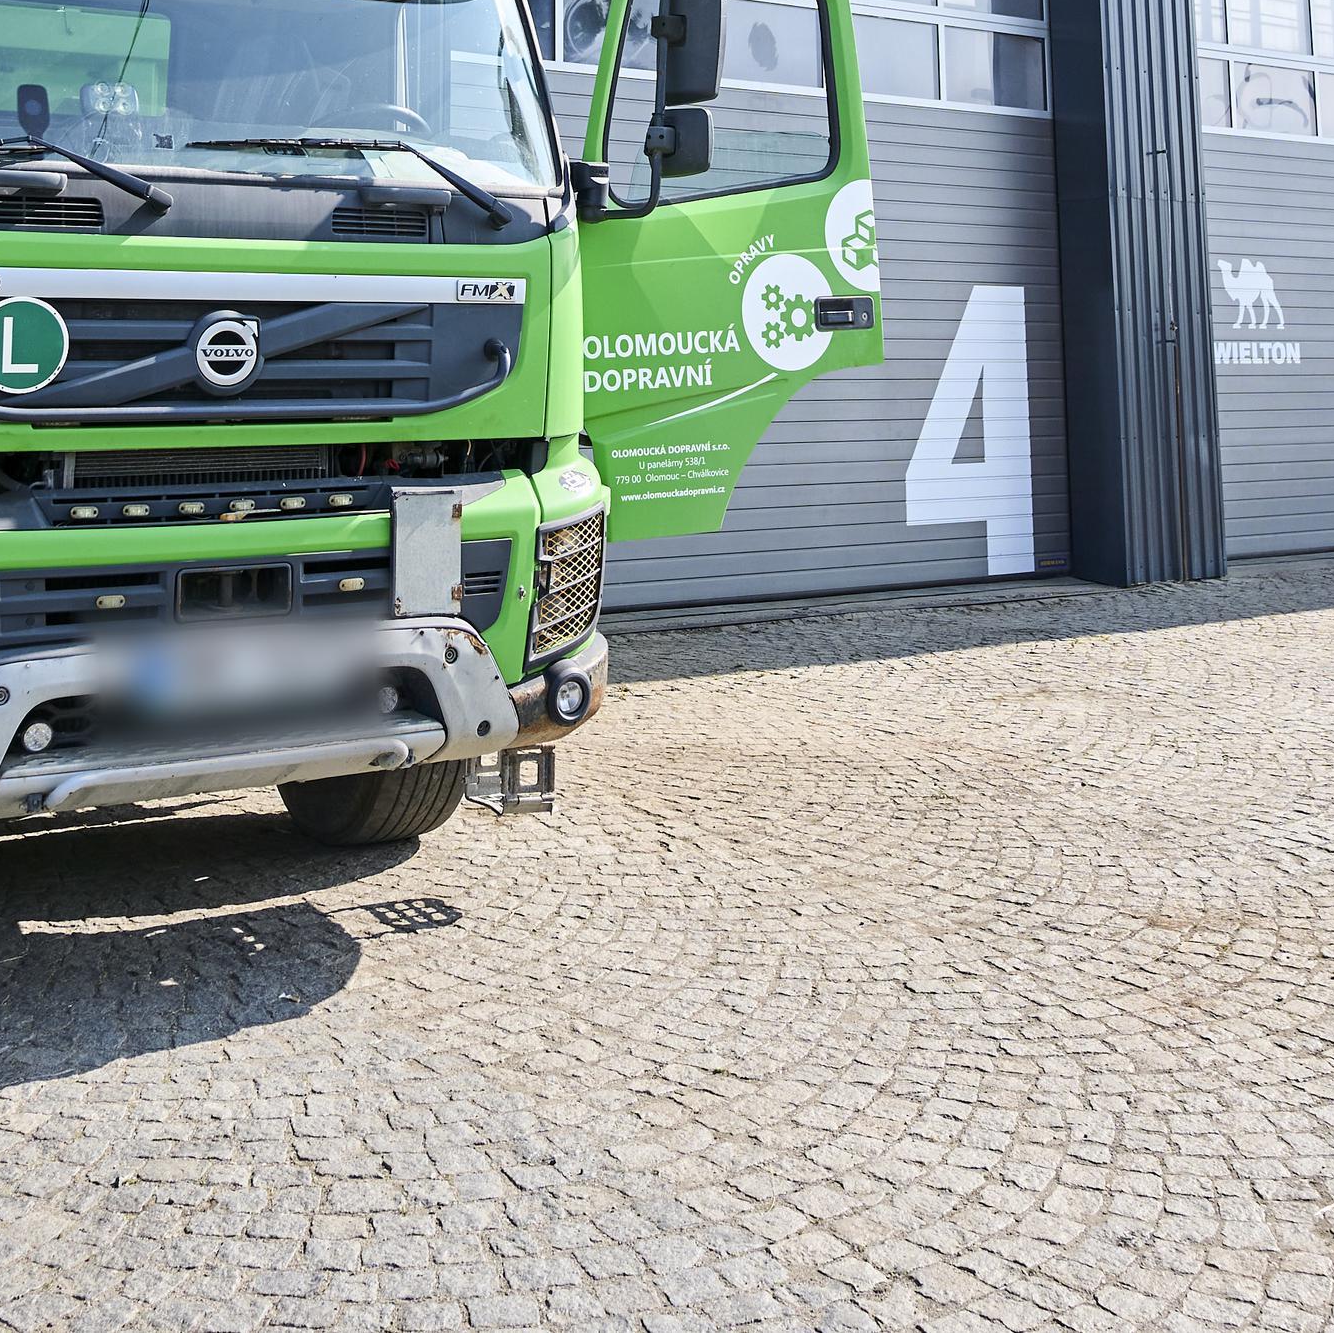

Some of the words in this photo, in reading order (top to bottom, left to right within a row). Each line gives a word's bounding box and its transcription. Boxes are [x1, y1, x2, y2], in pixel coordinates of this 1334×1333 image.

[728, 234, 774, 285] OPRAVY
[460, 282, 515, 300] FMX
[2, 316, 39, 373] L
[584, 323, 740, 360] OLOMOUCKÁ
[201, 348, 255, 359] VOLVO
[1213, 341, 1301, 365] WIELTON
[584, 358, 713, 393] DOPRAVNÍ
[906, 286, 1035, 575] 4
[611, 444, 666, 458] OLOMOUCKÁ
[668, 441, 711, 454] DOPRAVNÍ
[712, 443, 731, 451] s.r.o.
[639, 461, 645, 469] U
[685, 456, 706, 466] 538/1
[615, 475, 630, 485] 779
[631, 474, 641, 484] 00
[645, 472, 680, 482] Olomouc
[687, 467, 729, 479] Chválkovice
[621, 485, 725, 502] www.olomouckadopravni.cz
